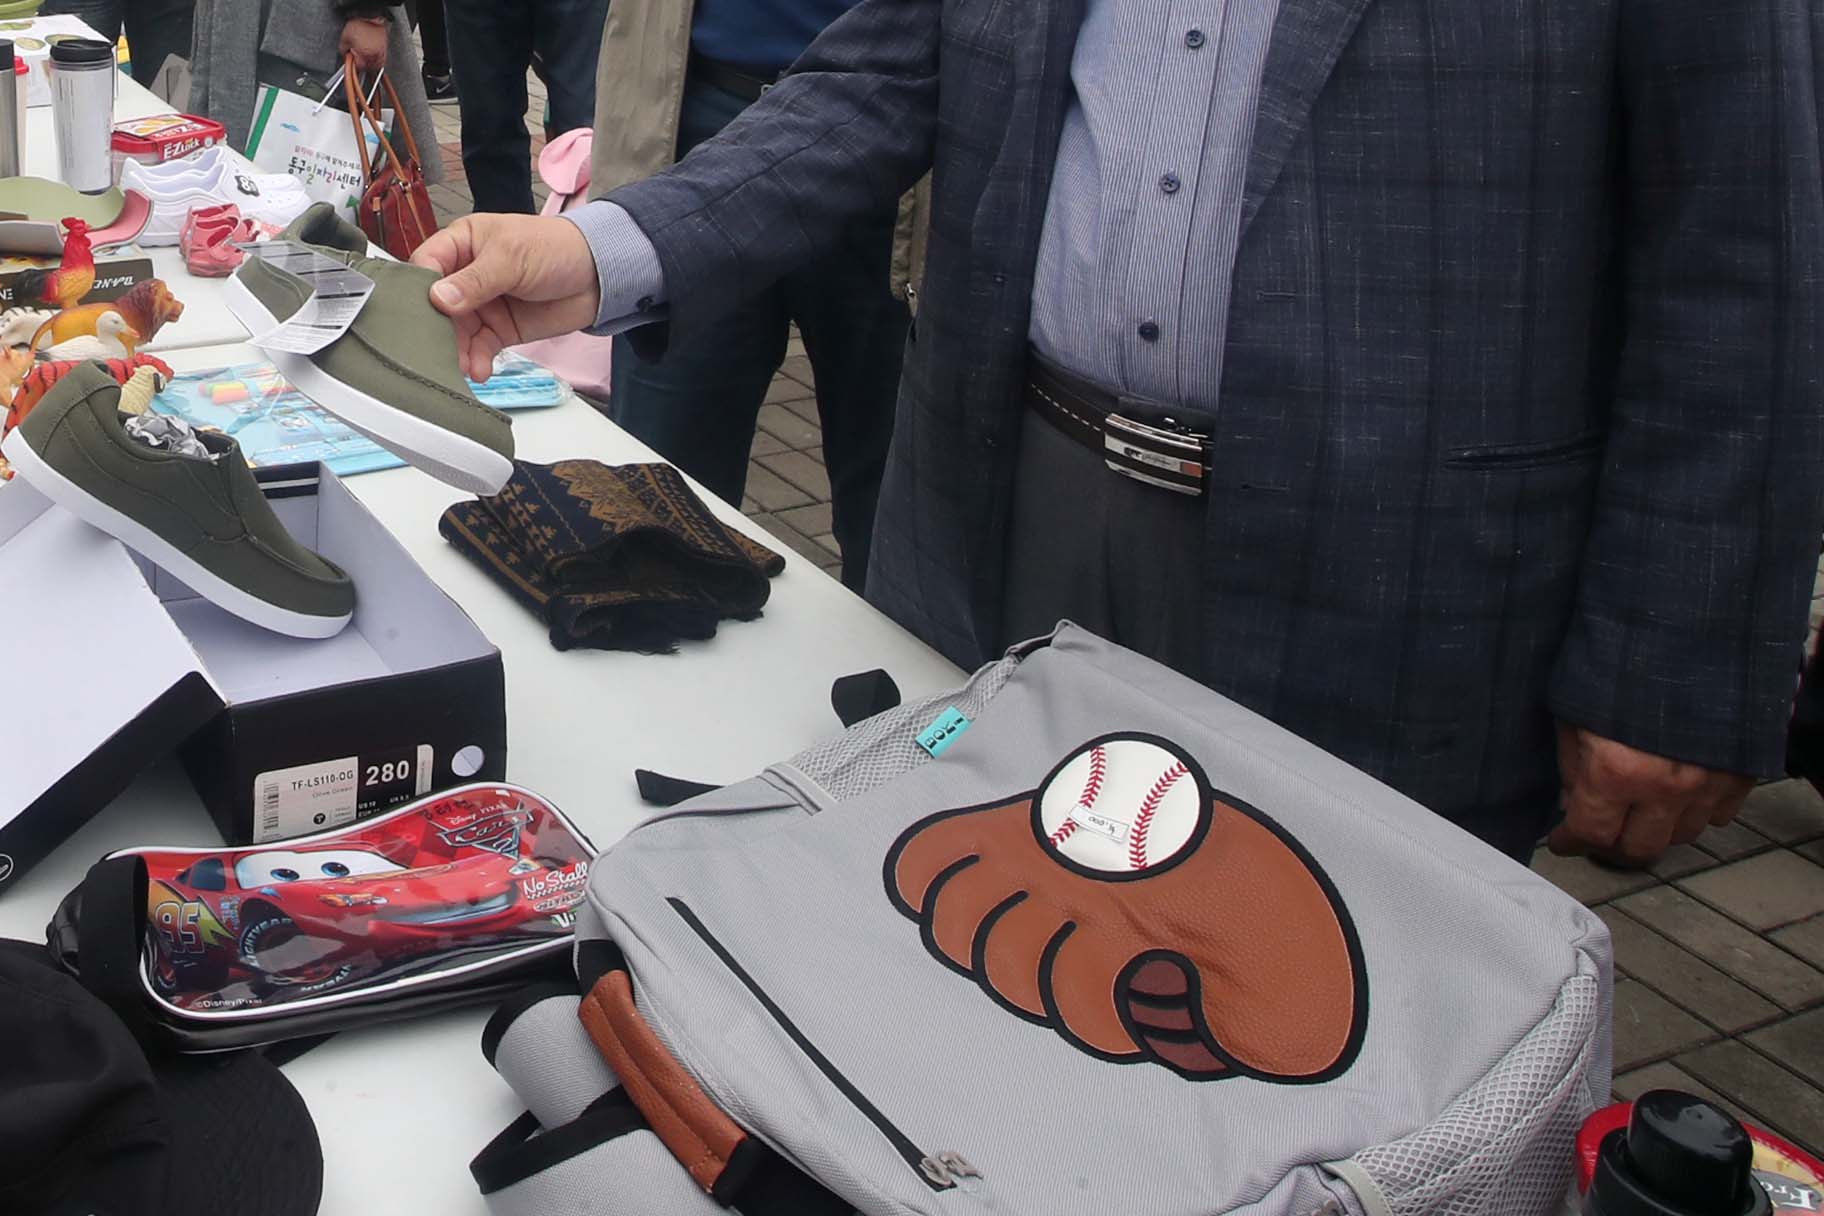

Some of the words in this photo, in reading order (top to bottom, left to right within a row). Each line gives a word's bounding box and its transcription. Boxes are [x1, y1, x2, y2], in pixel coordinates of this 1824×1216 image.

[288, 156, 361, 190] 동구일자리센터
[365, 759, 410, 786] 280
[523, 878, 545, 896] No
[545, 861, 588, 888] Stall
[155, 900, 205, 954] 95
